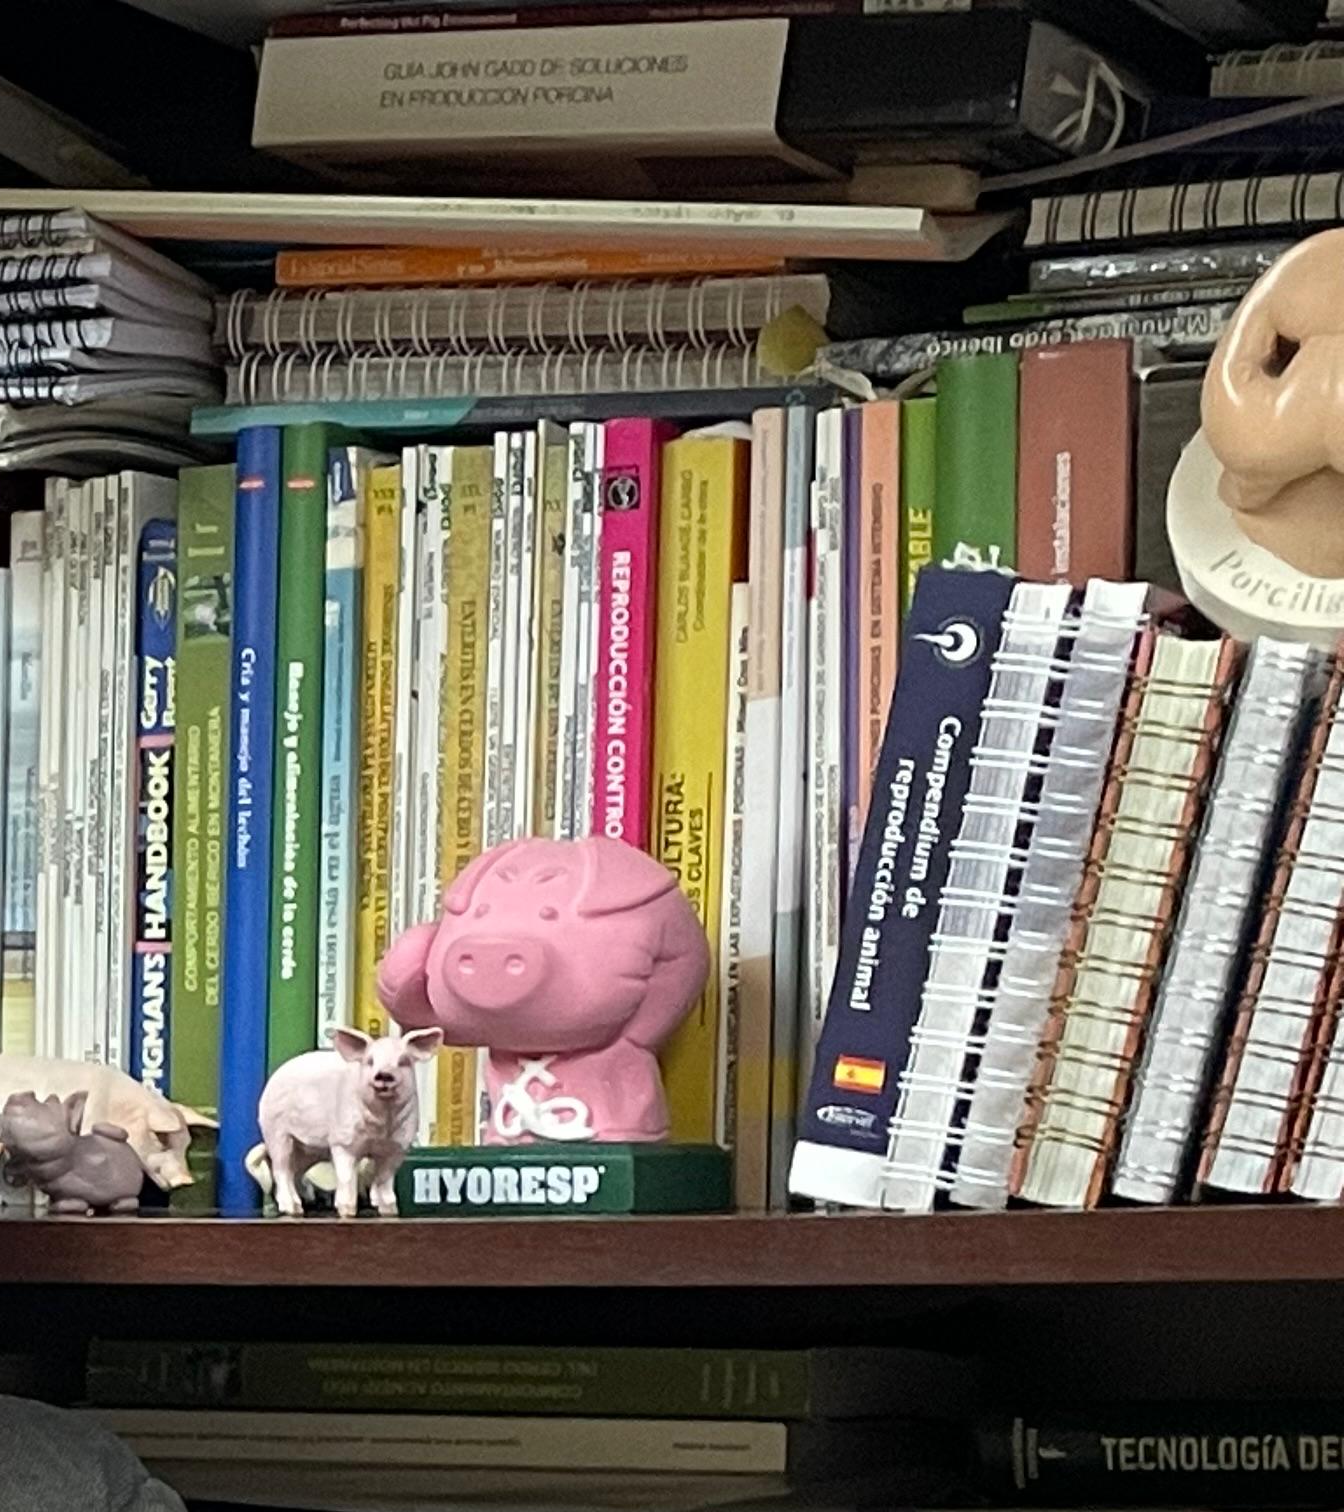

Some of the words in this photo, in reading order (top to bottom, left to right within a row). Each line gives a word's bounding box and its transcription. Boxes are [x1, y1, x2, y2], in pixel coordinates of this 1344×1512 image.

[421, 13, 442, 30] Pig
[430, 59, 481, 79] JOHN
[539, 56, 566, 77] DE
[568, 54, 689, 76] SOLUCIONES
[379, 90, 406, 108] EN
[532, 86, 614, 105] PORCINA
[926, 336, 1003, 356] Ibérico
[870, 482, 884, 555] INTENSIVO
[870, 556, 884, 617] SISTEMA
[606, 551, 633, 736] REPRODUCCIÓN
[870, 620, 883, 639] EN
[139, 655, 164, 730] Gerry
[238, 691, 252, 702] y
[283, 660, 306, 733] Manejo
[457, 683, 476, 707] EN
[869, 644, 884, 717] PORCINAS
[205, 705, 222, 810] MONTANERA
[237, 707, 253, 772] manejo
[283, 735, 300, 748] y
[457, 708, 475, 770] CERDOS
[183, 724, 202, 835] ALIMENTARIO
[237, 776, 254, 805] del
[324, 774, 346, 827] agua
[604, 738, 627, 839] CONTRO
[731, 745, 746, 815] PORCINAS
[908, 715, 964, 882] Compendium
[143, 749, 171, 940] HANDBOOK
[205, 813, 221, 836] EN
[322, 827, 342, 844] el
[687, 806, 704, 883] CLAVES
[868, 758, 917, 920] reproducción
[282, 875, 301, 900] de
[324, 854, 341, 883] en
[183, 837, 201, 992] COMPORTAMIENTO
[282, 901, 300, 922] la
[320, 886, 340, 932] está
[901, 889, 928, 918] de
[205, 911, 221, 970] CERDO
[280, 925, 298, 980] cerda
[727, 932, 741, 958] LAS
[204, 976, 220, 1006] DEL
[319, 933, 340, 1023] solución
[847, 927, 885, 1010] animal
[140, 952, 167, 1095] PIGMAN'S
[412, 1165, 602, 1205] HYORESP
[1099, 1433, 1289, 1472] TECNOLOGÍA
